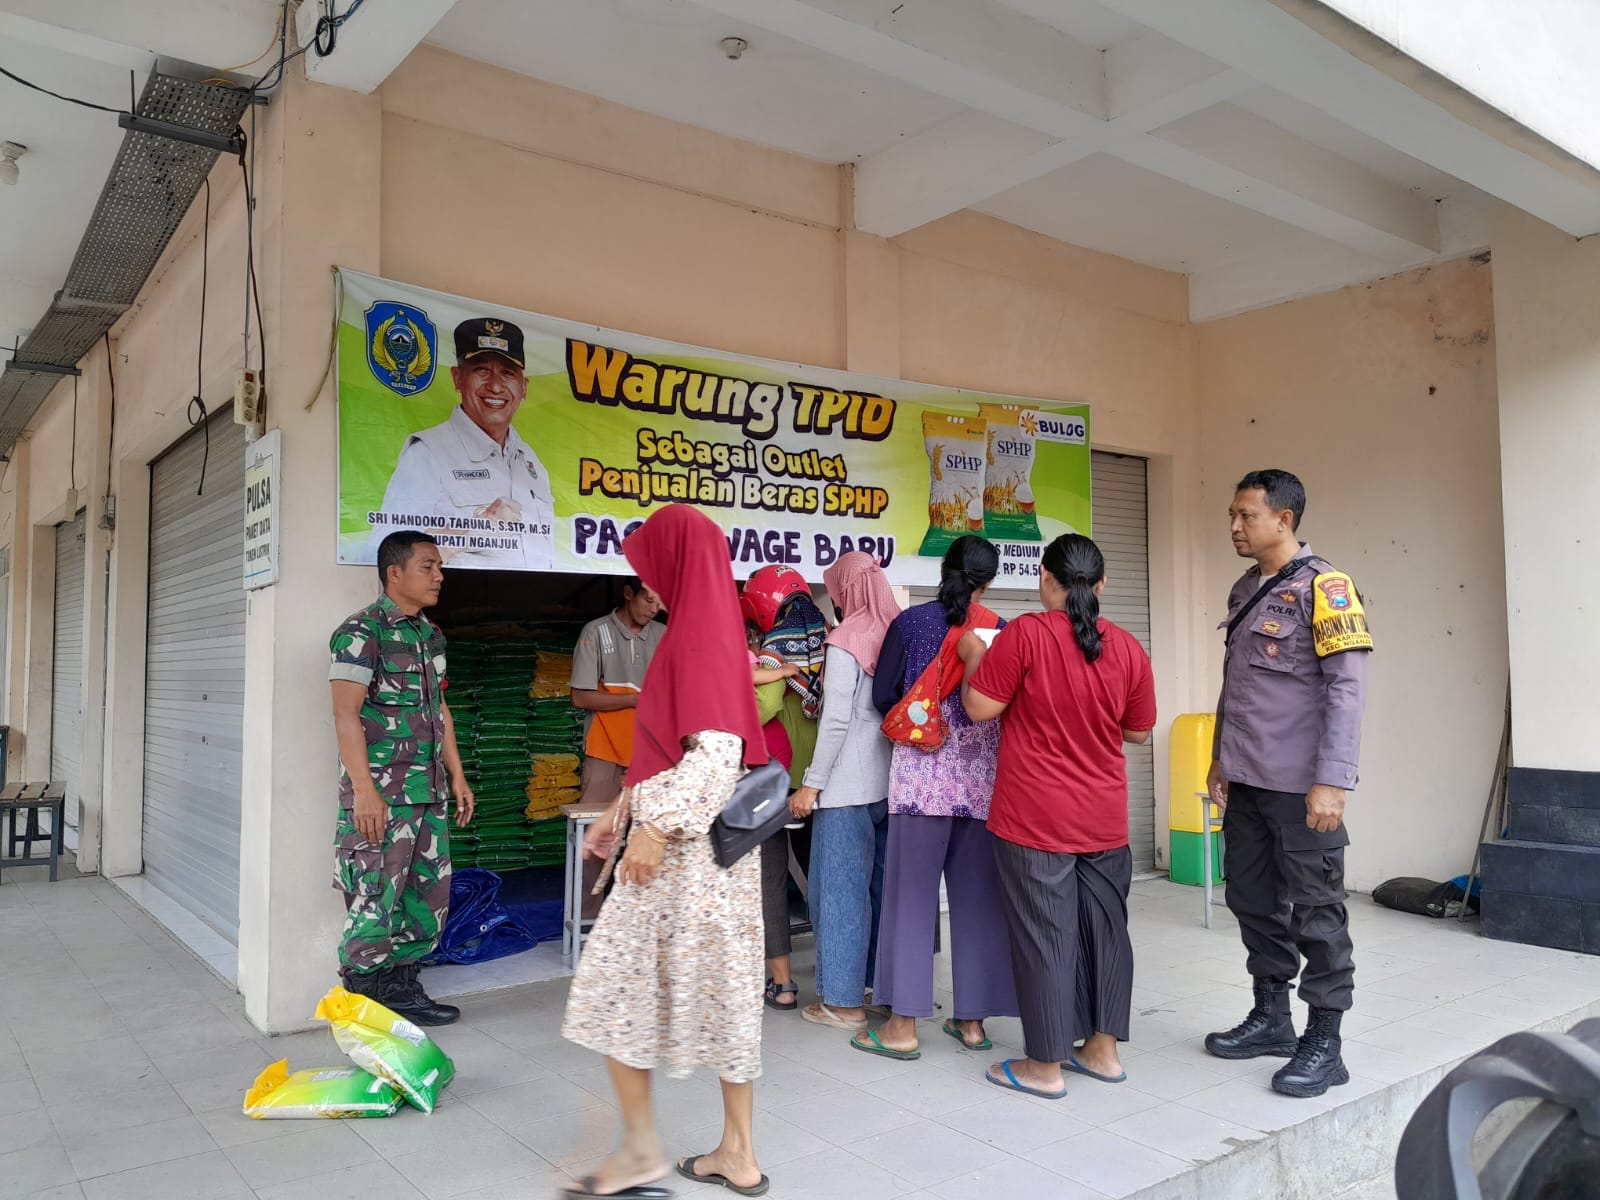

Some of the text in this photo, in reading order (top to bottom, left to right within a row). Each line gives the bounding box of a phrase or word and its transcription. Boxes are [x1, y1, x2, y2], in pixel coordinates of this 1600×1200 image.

[566, 338, 897, 441] Warung TPID
[1038, 420, 1085, 438] BULOG
[637, 428, 847, 483] Sebagai Outlet
[997, 440, 1032, 457] SPHP
[945, 454, 982, 472] SPHP
[246, 476, 271, 515] PULSA
[579, 457, 889, 519] Penjualan Beras SPHP
[368, 512, 388, 525] SRI
[391, 513, 446, 528] HANDOKO
[449, 517, 495, 533] TARUNA,
[434, 534, 519, 550] UPATI NGANJUK
[1003, 544, 1041, 558] MEDIUM
[1003, 563, 1041, 576] RP 54.5
[1266, 603, 1297, 616] POLRI
